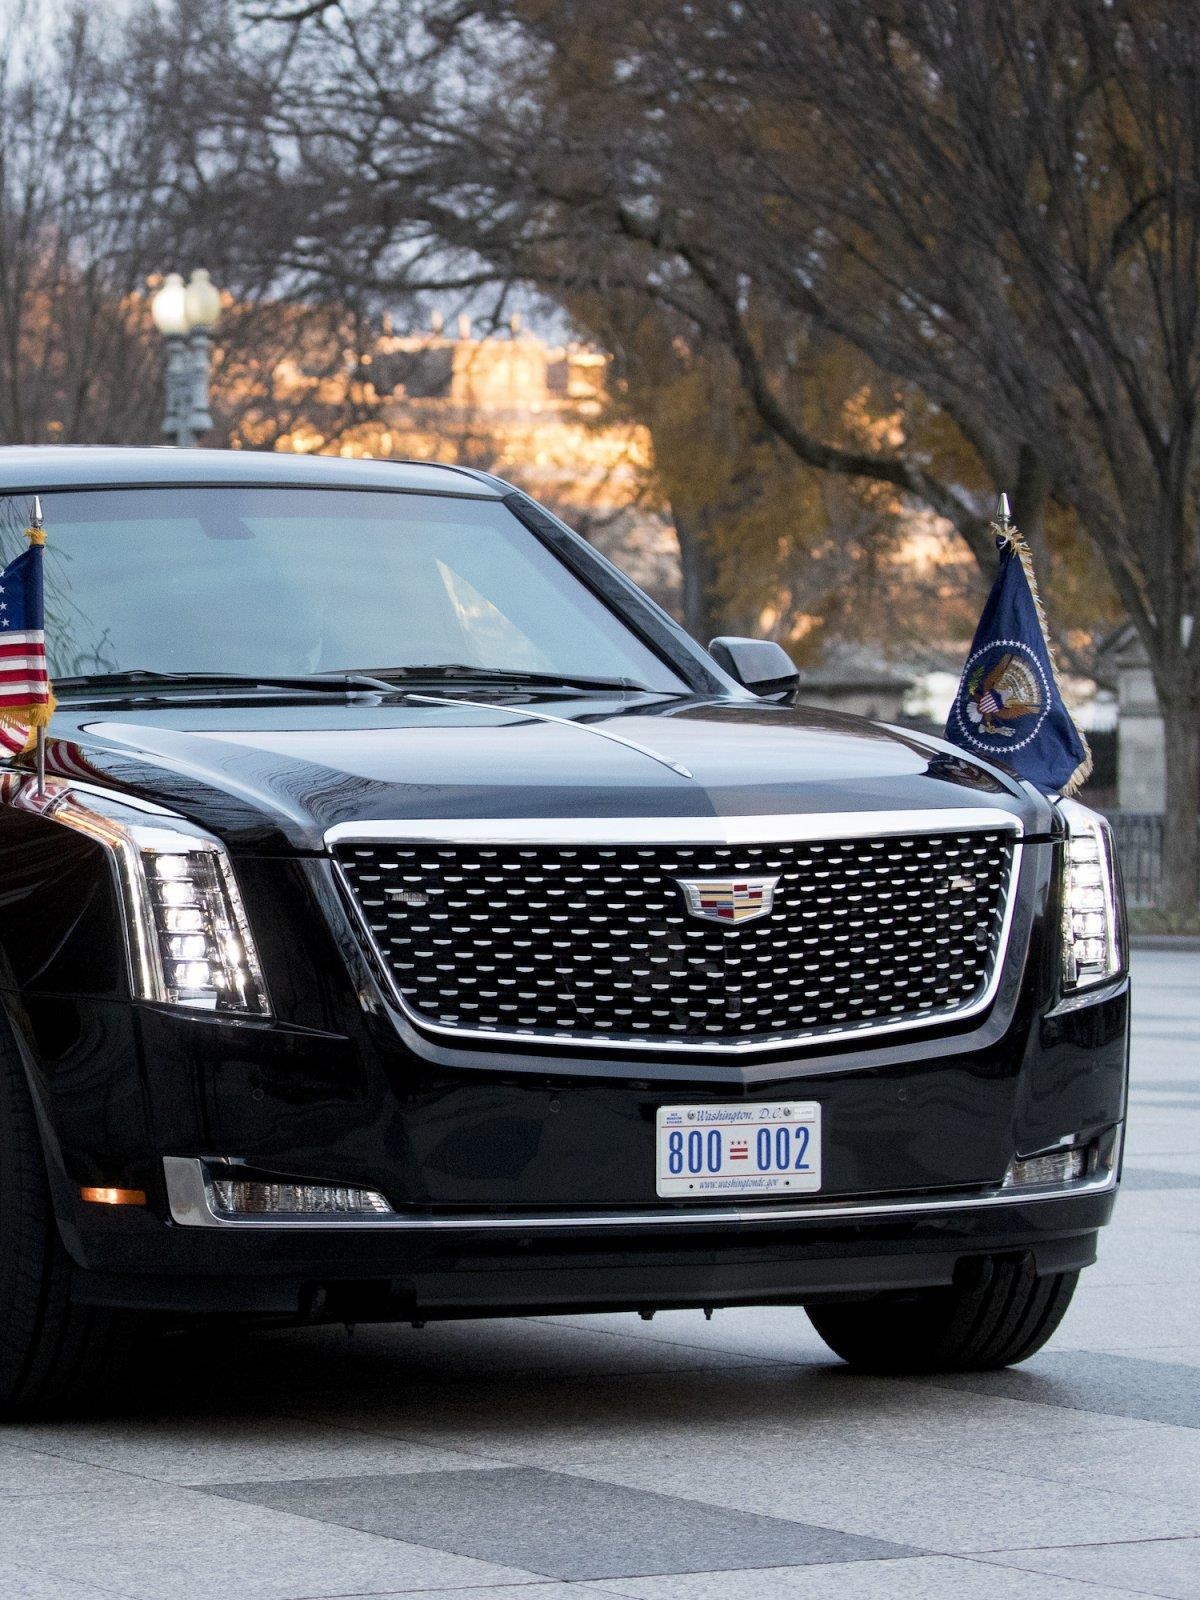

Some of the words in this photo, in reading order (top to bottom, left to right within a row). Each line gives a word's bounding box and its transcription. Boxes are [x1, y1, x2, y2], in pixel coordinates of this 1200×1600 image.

[759, 1108, 782, 1120] D.C.
[669, 1130, 722, 1174] 800
[757, 1126, 810, 1171] 002
